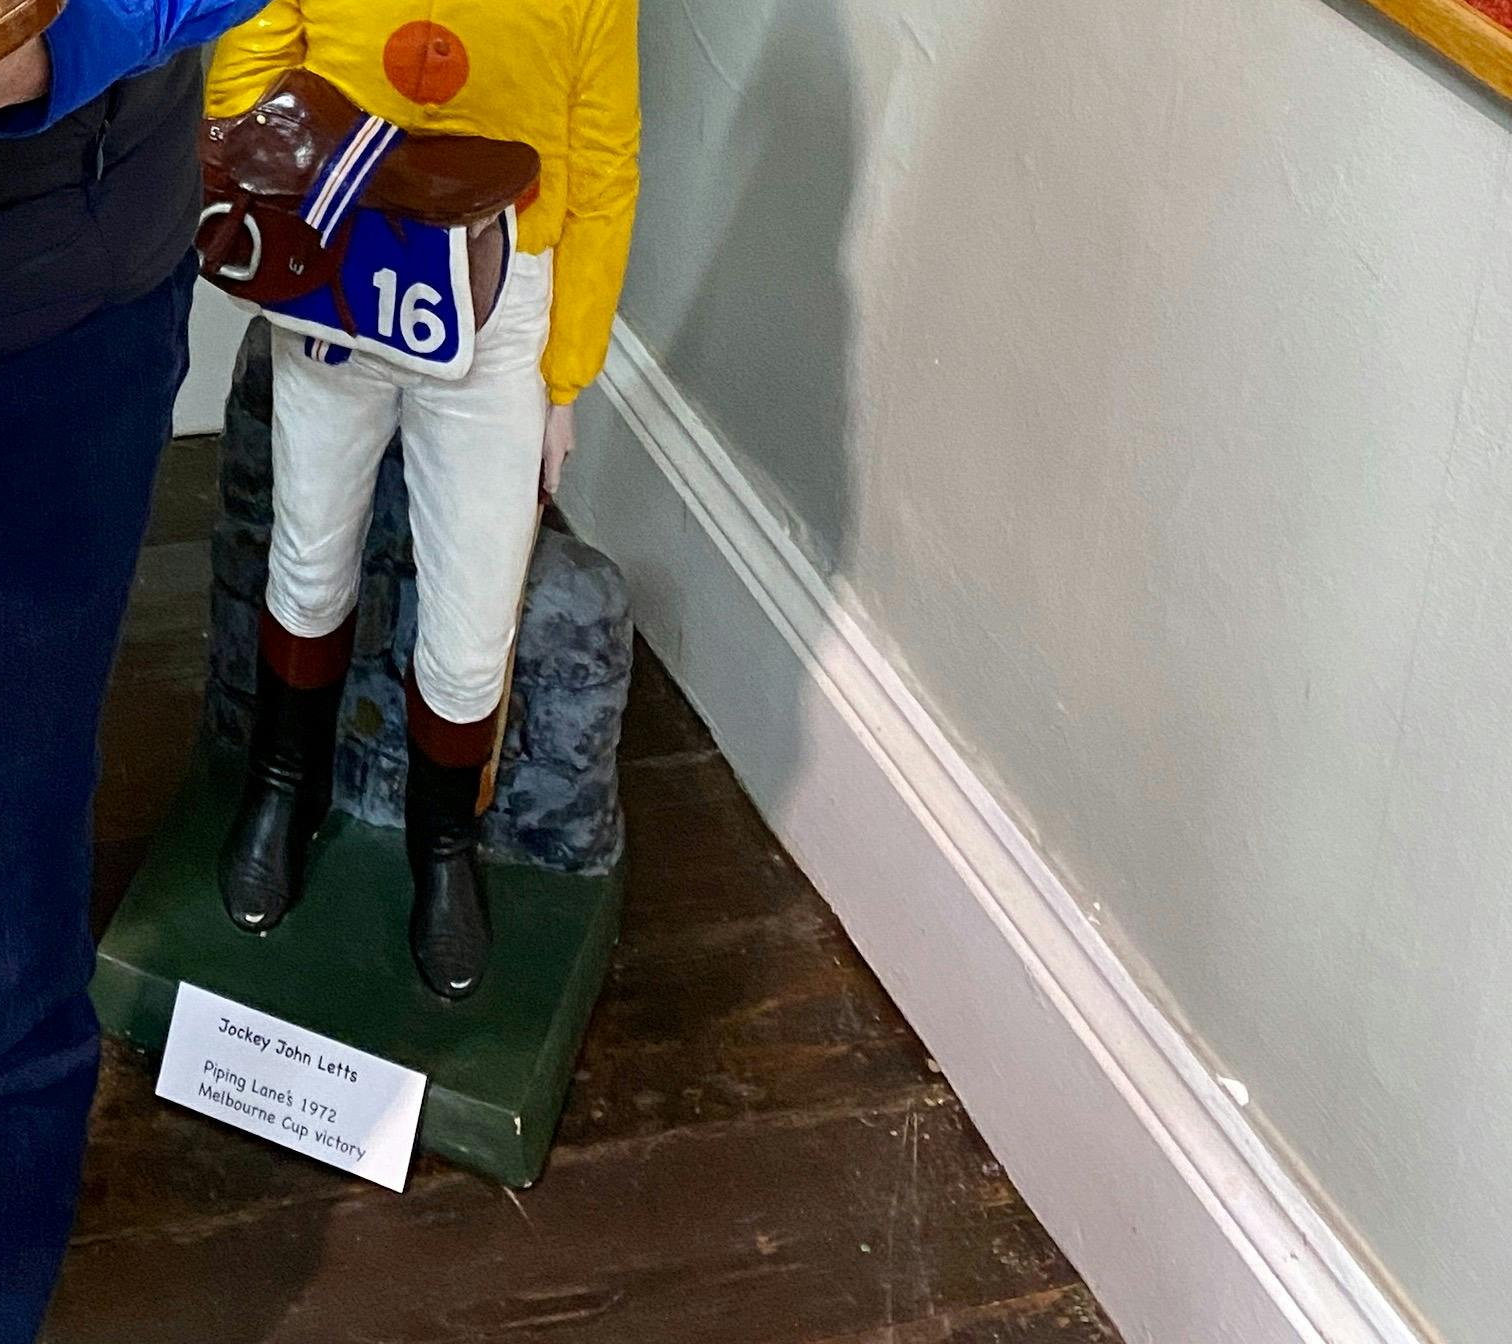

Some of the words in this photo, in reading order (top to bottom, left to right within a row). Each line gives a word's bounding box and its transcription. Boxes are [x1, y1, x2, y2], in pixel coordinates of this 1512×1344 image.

[372, 268, 446, 354] 16
[218, 1018, 271, 1052] Jockey
[275, 1039, 312, 1064] John
[317, 1055, 357, 1083] Letts
[198, 1082, 276, 1124] Melbourne
[281, 1116, 309, 1141] Cup
[314, 1130, 367, 1162] victory
[203, 1060, 246, 1092] Piping
[251, 1078, 293, 1107] Lane's
[301, 1098, 337, 1123] 1972
